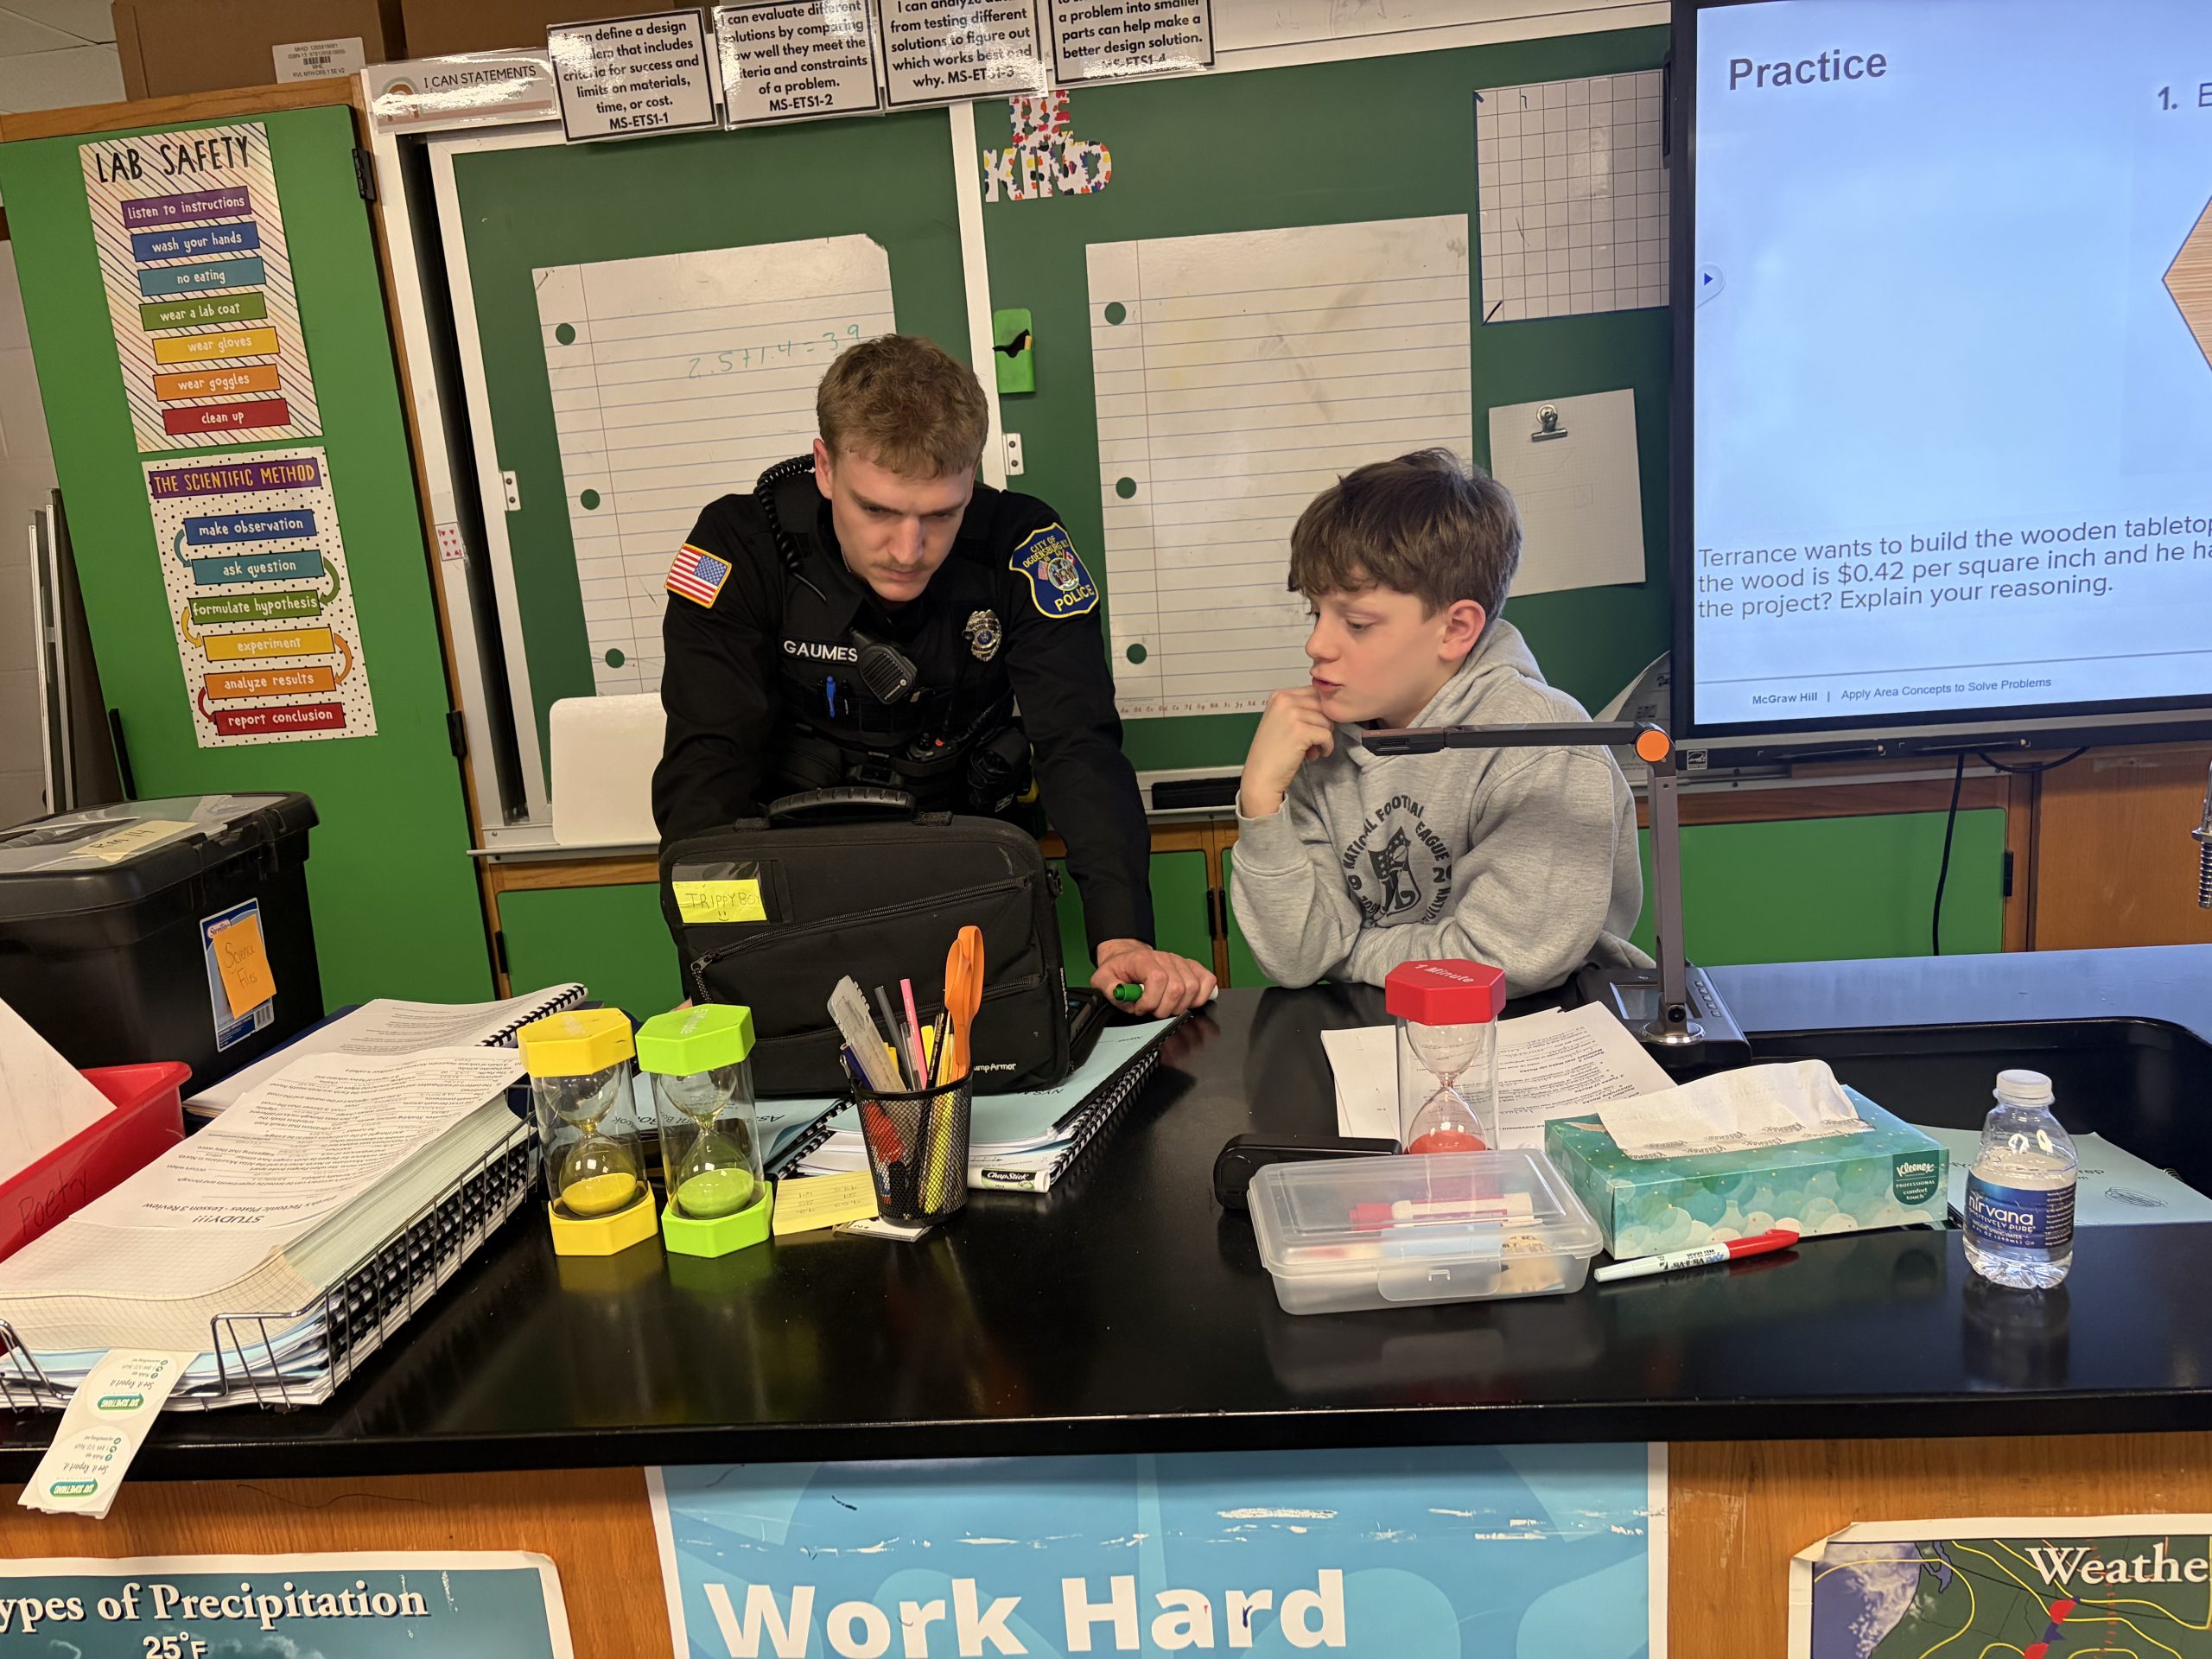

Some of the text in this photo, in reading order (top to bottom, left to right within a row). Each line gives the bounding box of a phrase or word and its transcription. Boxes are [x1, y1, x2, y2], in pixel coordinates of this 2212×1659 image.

[728, 7, 804, 25] can evaluate
[905, 1, 928, 12] can
[1058, 1, 1151, 24] a problem into
[594, 27, 632, 41] define
[646, 21, 687, 35] design
[890, 8, 1027, 34] from testing different
[1062, 16, 1201, 43] parts can help make a
[779, 28, 794, 40] by
[891, 27, 1031, 53] solutions to figure out
[616, 43, 642, 57] that
[644, 39, 693, 54] includes
[753, 36, 866, 58] well they meet the
[1063, 33, 1203, 59] better design solution.
[608, 54, 699, 76] for success and
[773, 55, 868, 74] and constraints
[892, 57, 930, 71] which
[933, 53, 974, 66] works
[1728, 48, 1887, 91] Practice
[431, 73, 459, 87] CAN
[461, 65, 537, 84] STATEMENTS
[576, 73, 691, 98] limits on materials,
[759, 77, 840, 95] of a problem.
[912, 73, 944, 89] why.
[596, 95, 673, 114] time, or cost.
[769, 93, 834, 111] MS-ETS1-2
[2158, 86, 2177, 111] 1.
[609, 111, 669, 130] MS-ETS1-1
[96, 136, 250, 183] LAB SAFETY
[983, 130, 1112, 202] KIND
[127, 196, 245, 219] listen to instructions
[151, 231, 242, 253] wash your hands
[177, 269, 226, 284] no eating
[159, 302, 241, 321] wear a lab coat
[187, 336, 252, 353] wear gloves
[178, 373, 250, 391] wear goggles
[201, 411, 245, 424] clean up
[154, 464, 315, 494] THE SCIENTIFIC METHOD
[199, 518, 303, 537] make observation
[1030, 535, 1056, 553] CITY OF
[1698, 547, 1796, 568] Terrance
[1804, 539, 1872, 560] wants
[1879, 537, 1902, 555] to
[1910, 531, 1967, 553] build
[1974, 529, 2013, 549] the
[2020, 521, 2117, 545] wooden
[223, 558, 296, 578] ask question
[1698, 575, 1733, 593] the
[1741, 568, 1804, 590] wood
[1813, 567, 1829, 586] is
[1838, 561, 1904, 586] $0.42
[1912, 562, 1952, 583] per
[1958, 556, 2039, 579] square
[2048, 548, 2095, 569] inch
[2104, 543, 2147, 566] and
[2156, 543, 2185, 562] he
[193, 595, 318, 617] formulate hypothesis
[1054, 584, 1095, 612] POLICE
[1698, 575, 2114, 620] the project? Explain your reasoning.
[237, 637, 302, 654] experiment
[784, 640, 858, 662] GAUMES
[224, 672, 315, 693] analyze results
[1752, 677, 2051, 705] McGraw Hill Apply Area Concepts to Solve Problems
[228, 708, 334, 729] report conclusion
[1415, 821, 1450, 861] EAGUE
[237, 967, 257, 988] Files
[1424, 967, 1474, 983] Minute
[987, 1172, 1027, 1180] ChapStick
[1897, 1162, 1935, 1177] Kleenex
[1896, 1179, 1936, 1188] PROFESSIONAL
[18, 1167, 87, 1237] Poetry
[142, 1203, 181, 1211] Review
[261, 1203, 302, 1212] Tectonic
[1968, 1192, 2034, 1225] nirvana
[192, 1215, 265, 1224] STUDY!!!
[2009, 1224, 2033, 1233] PURE
[129, 1399, 140, 1408] SAY
[69, 1462, 109, 1475] See Report
[84, 1484, 94, 1494] SAY
[97, 1582, 140, 1623] of
[149, 1579, 431, 1631] Precipitation
[702, 1568, 1346, 1659] Work Hard
[143, 1630, 209, 1659] 25°F
